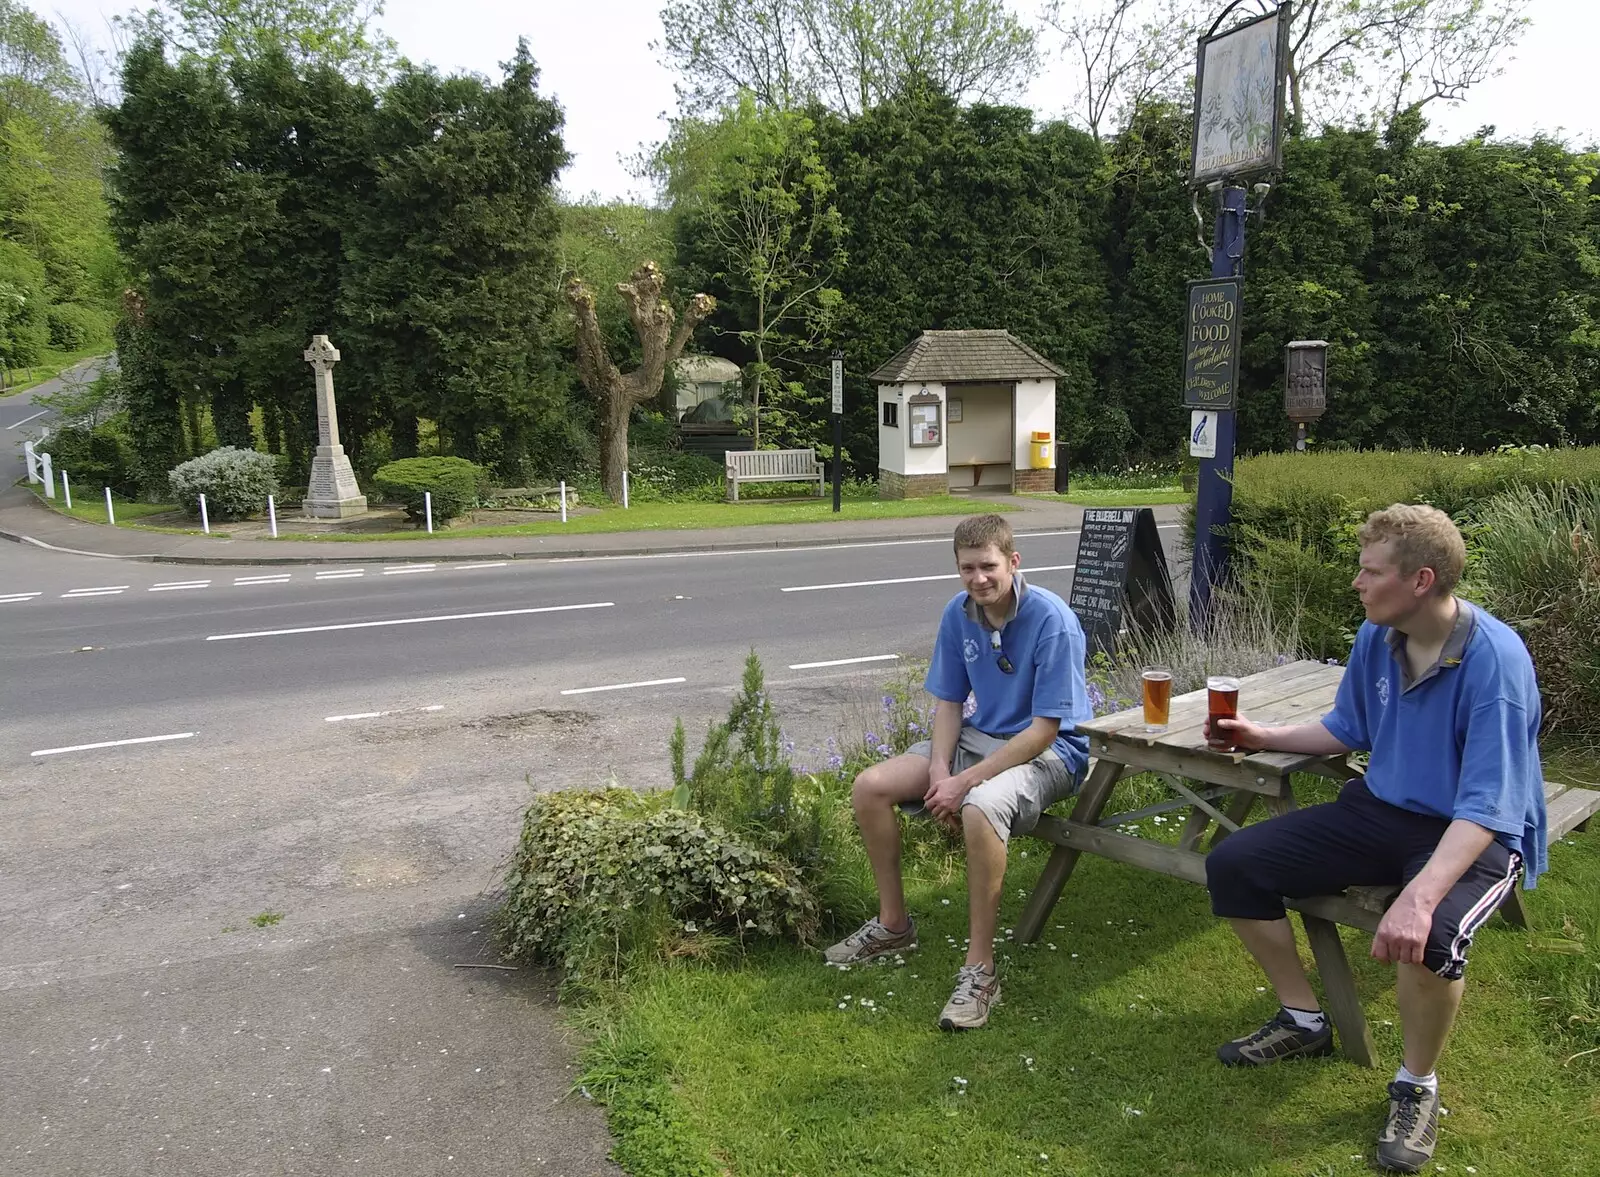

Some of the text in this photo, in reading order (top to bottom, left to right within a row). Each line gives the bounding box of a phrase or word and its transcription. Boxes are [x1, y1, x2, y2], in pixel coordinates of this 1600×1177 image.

[1202, 292, 1225, 303] HOME
[1192, 301, 1234, 323] COOKED
[1192, 324, 1230, 341] FOOD
[1199, 382, 1230, 400] WELCOME
[1085, 510, 1134, 523] THE BLUEBELL INN
[1071, 593, 1088, 606] LARGE
[1088, 596, 1098, 608] CAR
[1098, 597, 1112, 610] PARK
